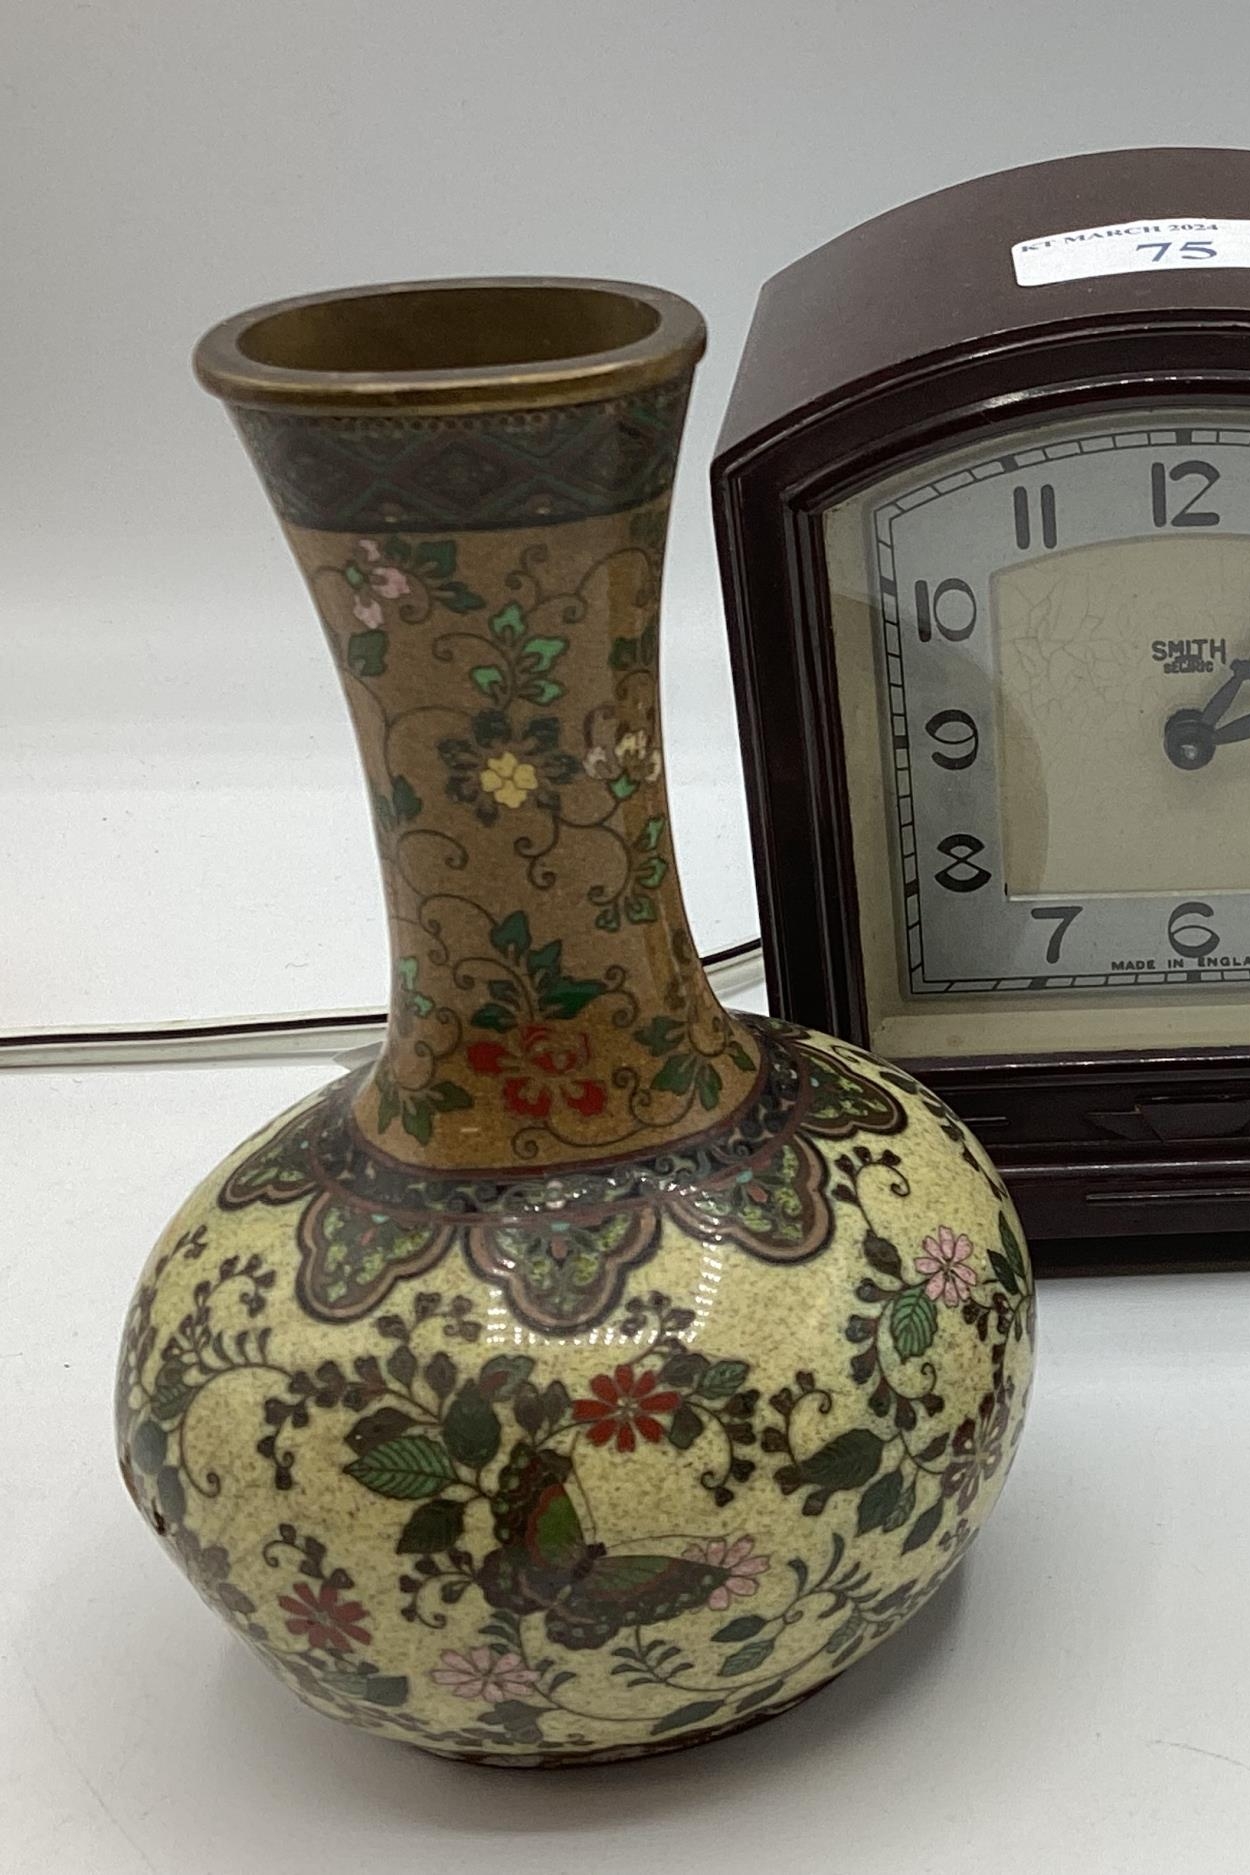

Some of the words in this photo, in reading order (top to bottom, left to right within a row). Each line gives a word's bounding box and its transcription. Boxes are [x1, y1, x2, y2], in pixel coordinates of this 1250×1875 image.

[1064, 226, 1161, 244] MARCH
[1168, 223, 1219, 232] 2024
[1136, 241, 1218, 262] 75
[1012, 484, 1058, 550] 11
[1151, 459, 1220, 528] 12
[914, 577, 978, 643] 10
[1151, 638, 1226, 664] SMITH
[924, 709, 979, 770] 9
[933, 833, 992, 893] 8
[1030, 905, 1084, 964] 7
[1167, 901, 1220, 959] 6
[1111, 960, 1156, 971] MADE
[1167, 958, 1185, 969] IN
